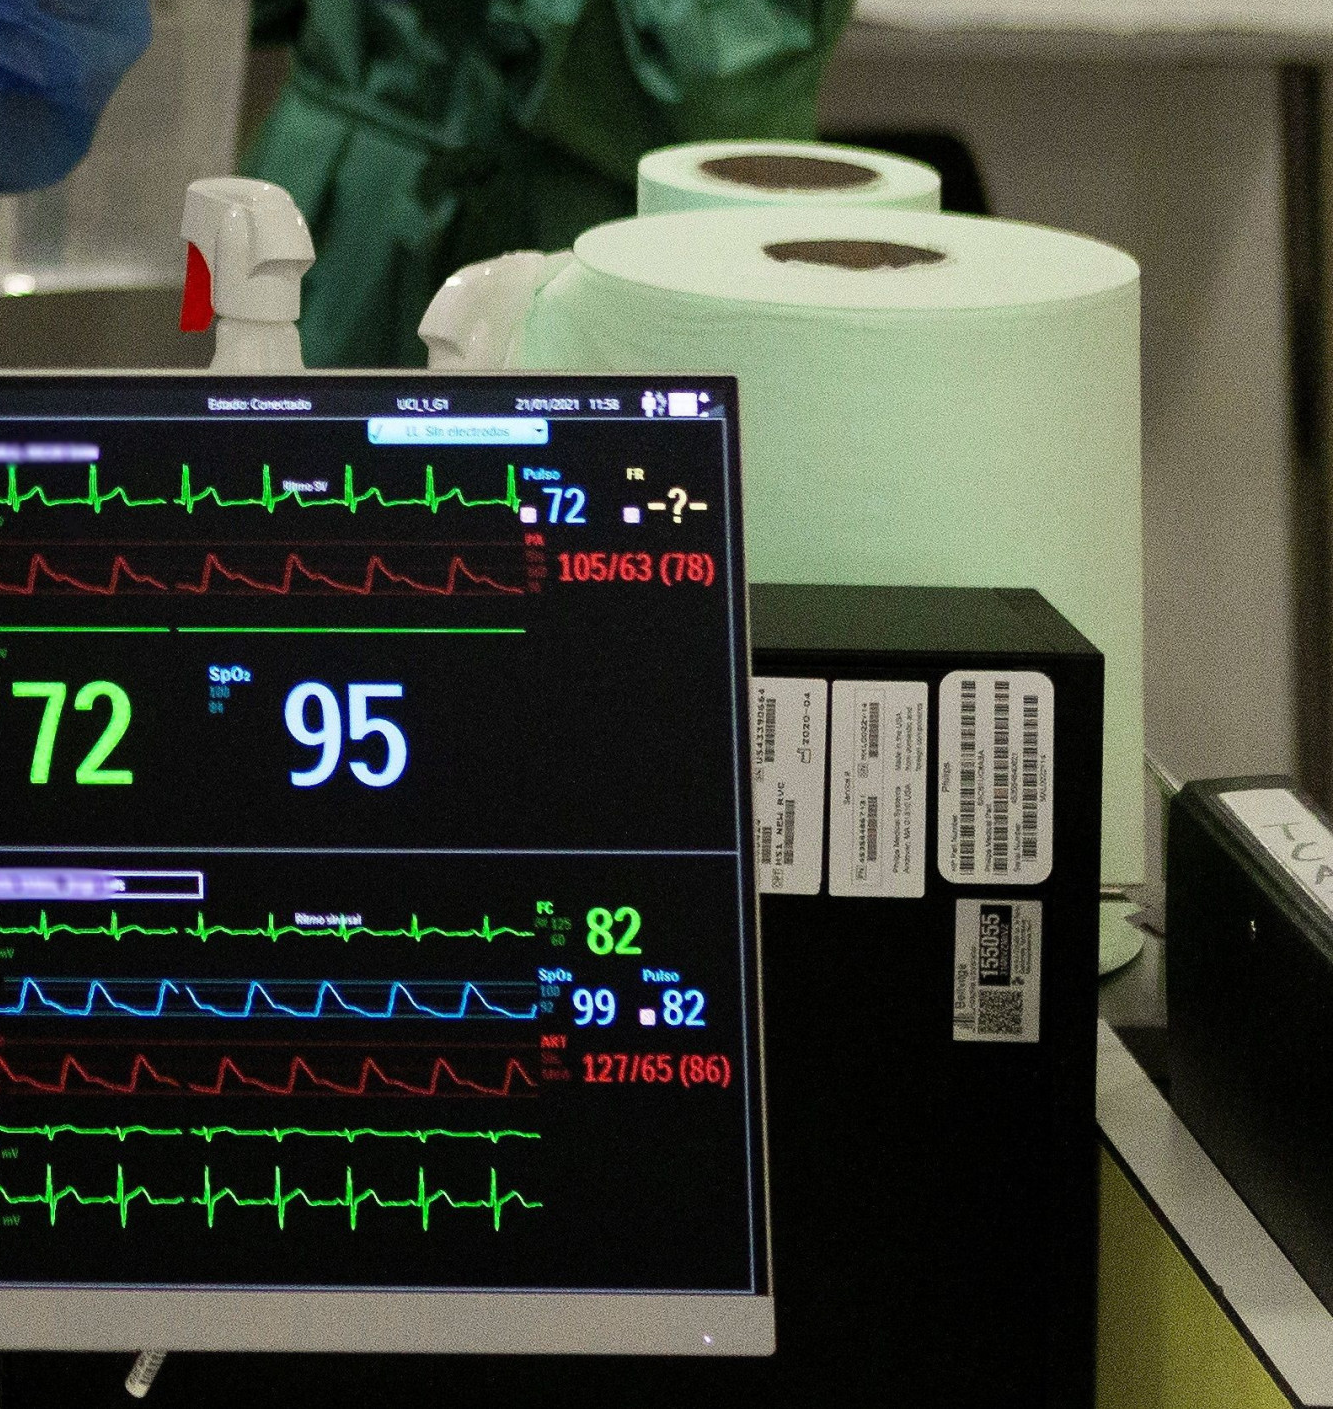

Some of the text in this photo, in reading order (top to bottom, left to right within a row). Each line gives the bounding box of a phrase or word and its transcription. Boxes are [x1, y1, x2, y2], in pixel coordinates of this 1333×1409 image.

[522, 467, 561, 481] Pulso
[626, 467, 645, 481] FR
[541, 487, 586, 523] 72
[558, 552, 653, 582] 105/63
[659, 552, 715, 587] (78)
[11, 680, 134, 785] 72
[283, 681, 409, 788] 95
[536, 901, 554, 914] FC
[586, 906, 642, 954] 82
[981, 913, 1000, 978] 155055
[642, 968, 680, 982] Pulso
[572, 988, 616, 1025] 99
[662, 989, 706, 1026] 82
[583, 1053, 674, 1083] 127/65
[679, 1053, 731, 1088] (86)
